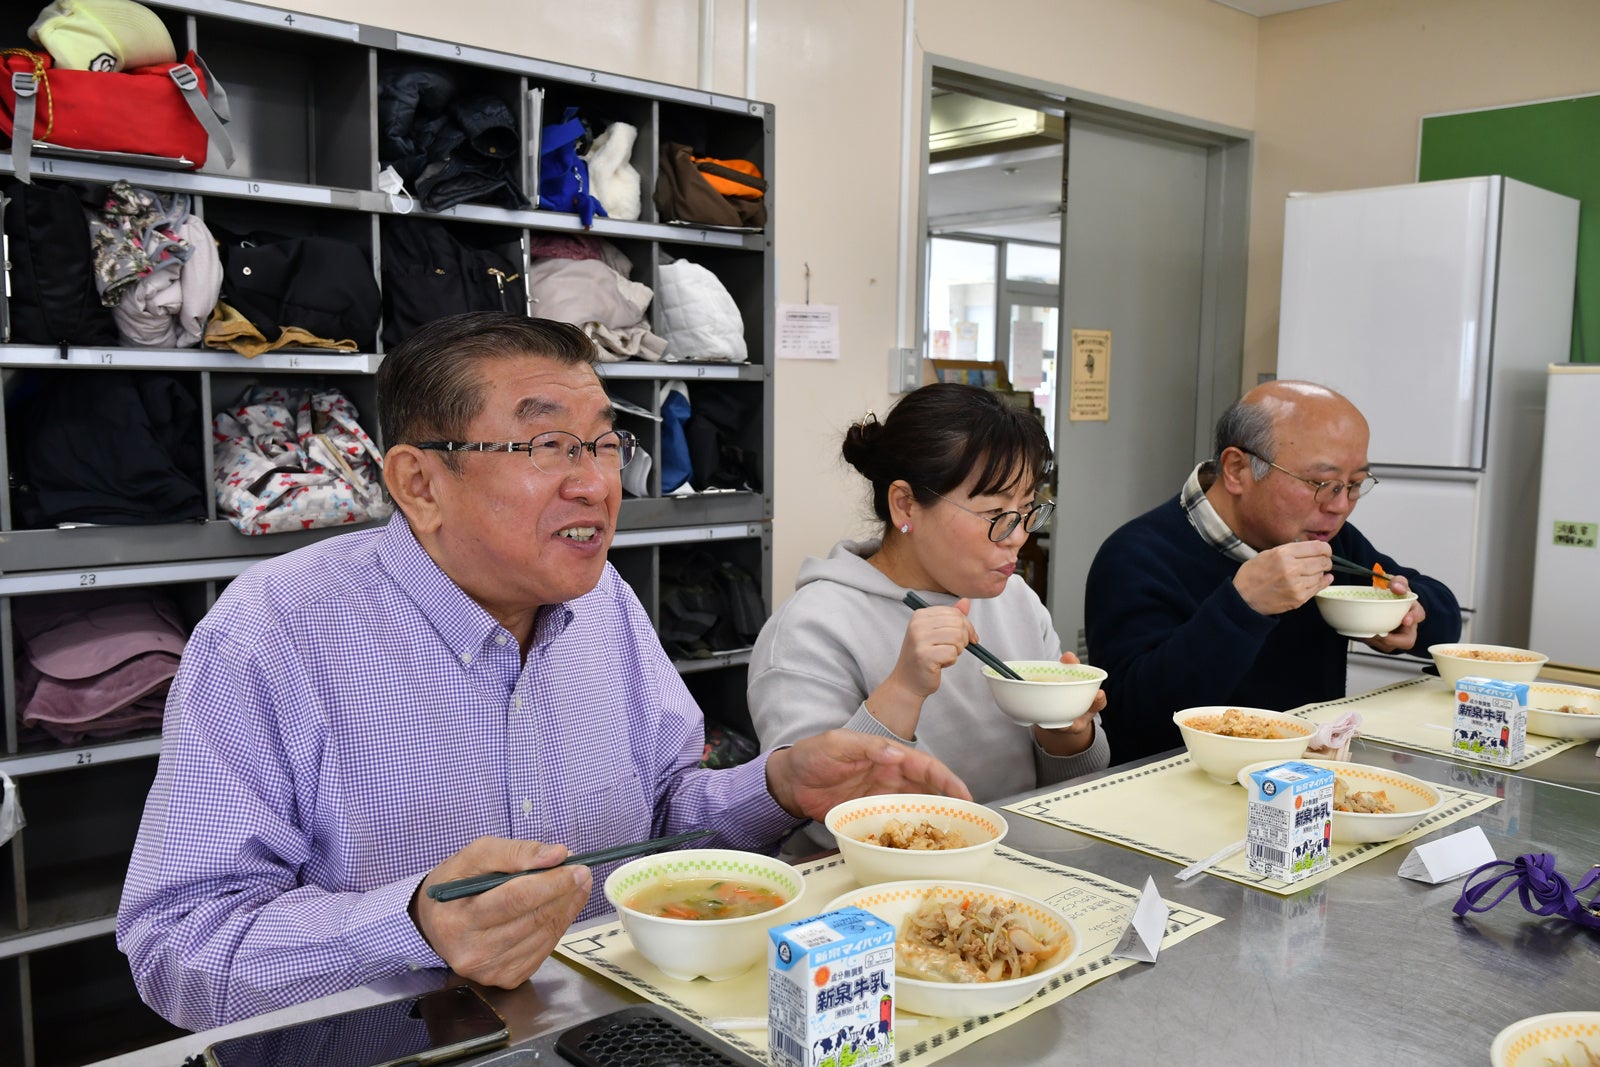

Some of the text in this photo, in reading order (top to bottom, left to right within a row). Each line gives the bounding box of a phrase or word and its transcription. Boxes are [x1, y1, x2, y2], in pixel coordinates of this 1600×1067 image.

[284, 14, 295, 26] 4
[455, 46, 462, 56] 3
[590, 72, 597, 83] 2
[41, 161, 54, 173] 11
[247, 183, 260, 194] 10
[699, 231, 707, 241] 7
[100, 353, 113, 365] 17
[79, 574, 97, 586] 23
[1458, 704, 1509, 724] 新泉牛乳
[1295, 801, 1330, 828] 新泉牛乳
[831, 965, 864, 983] 成分無調整
[816, 969, 891, 1014] 新泉牛乳
[855, 1000, 869, 1013] 牛乳
